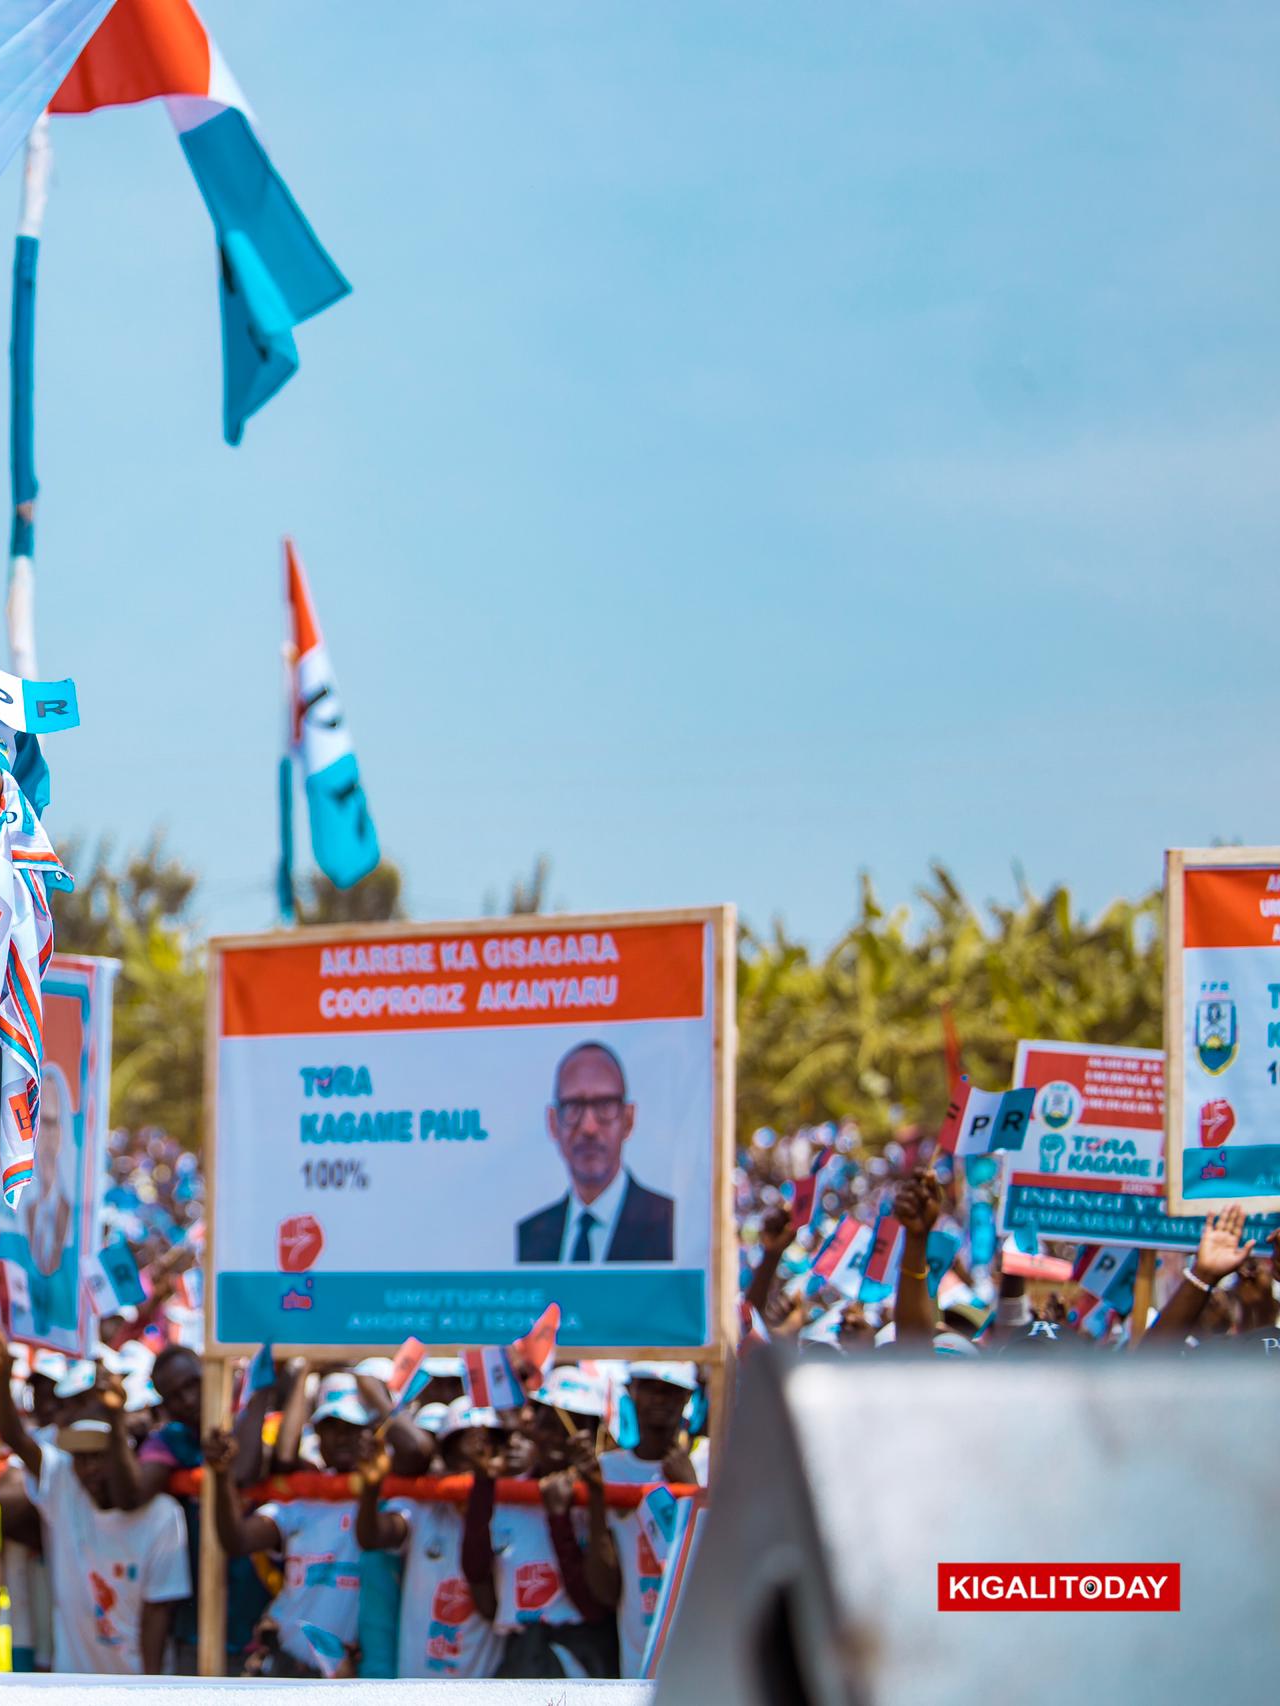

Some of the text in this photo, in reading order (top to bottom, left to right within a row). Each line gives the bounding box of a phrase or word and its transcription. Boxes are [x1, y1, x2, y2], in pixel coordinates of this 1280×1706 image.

[320, 933, 618, 977] AKARERE KA GISAGARA
[477, 975, 618, 1011] AKANYARU
[300, 1065, 373, 1098] TORA
[300, 1109, 489, 1144] KAGAME PAUL
[1072, 1135, 1137, 1157] TORA
[301, 1159, 369, 1190] 100%
[1068, 1154, 1152, 1178] KAGAME
